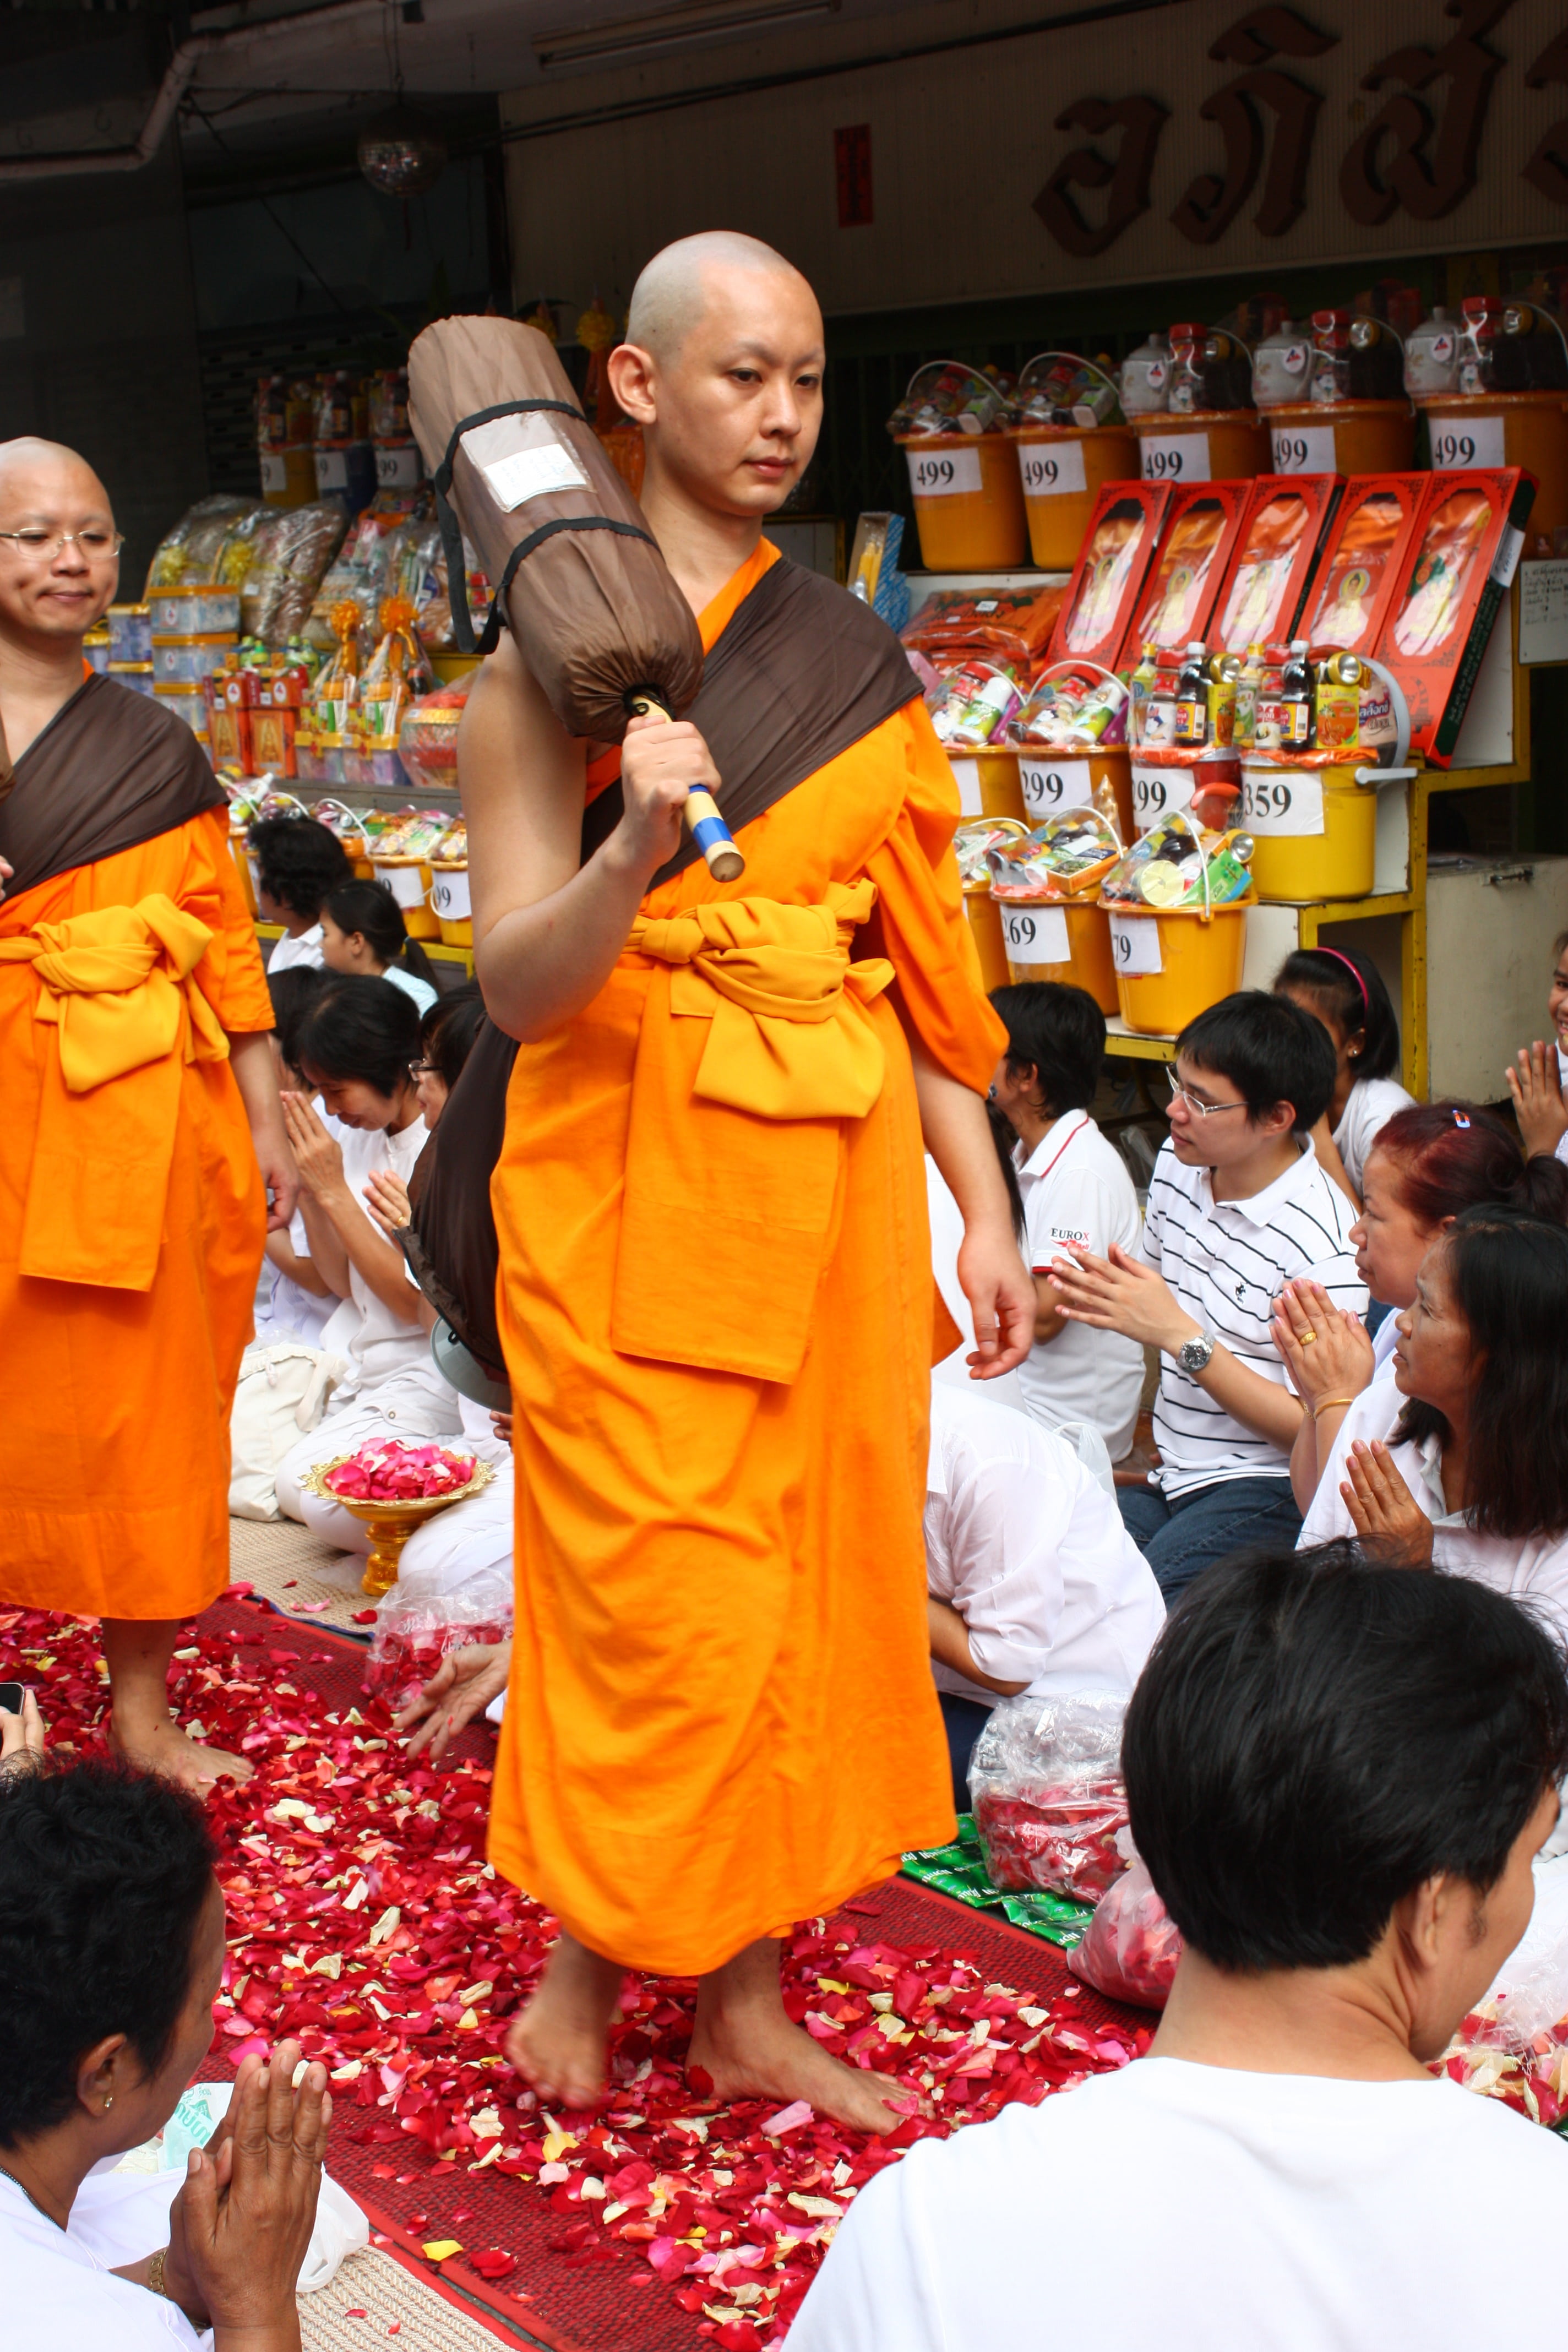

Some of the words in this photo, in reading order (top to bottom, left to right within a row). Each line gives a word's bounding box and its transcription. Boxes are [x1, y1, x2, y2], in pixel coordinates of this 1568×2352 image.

[1435, 435, 1476, 465] 499
[917, 460, 954, 486] 499
[1025, 459, 1058, 486] 499
[1146, 451, 1183, 478] 499
[1050, 1228, 1090, 1241] EUROX
